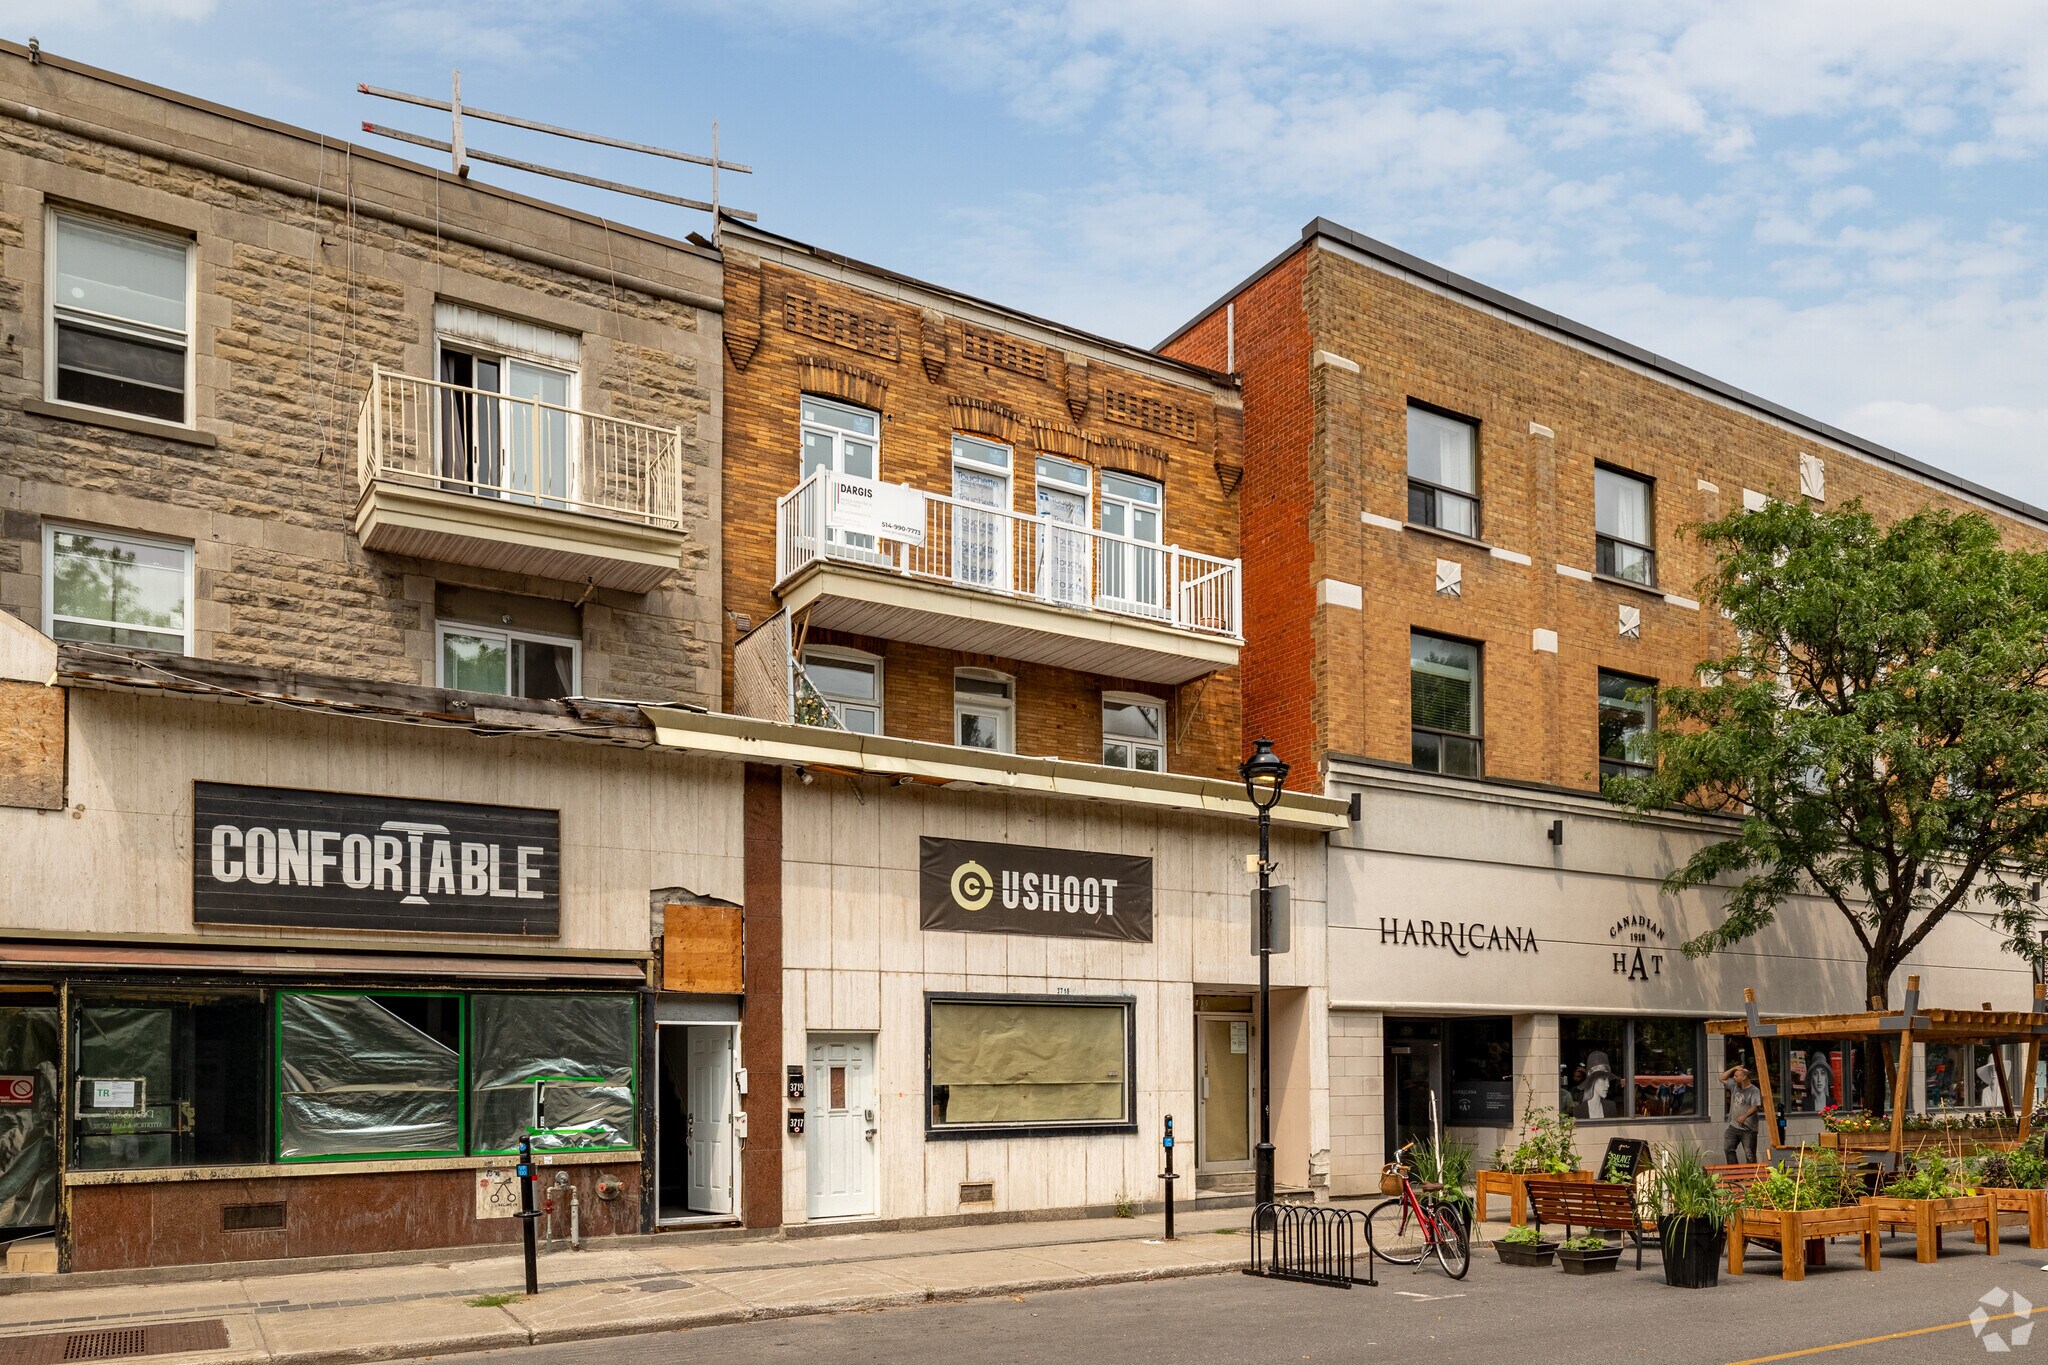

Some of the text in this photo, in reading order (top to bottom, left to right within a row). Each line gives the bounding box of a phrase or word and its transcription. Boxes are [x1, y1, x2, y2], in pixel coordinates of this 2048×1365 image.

[840, 483, 873, 498] DARGIS
[881, 521, 922, 536] 514-990-7773
[211, 820, 544, 905] CONFORTABLE
[1002, 870, 1118, 916] USHOOT
[1609, 914, 1665, 942] CANADIAN
[1379, 917, 1539, 956] HARRICANA
[1629, 932, 1646, 942] 1918
[1612, 947, 1663, 981] HAT
[97, 1088, 110, 1097] TR
[789, 1082, 804, 1091] 3719
[789, 1118, 804, 1127] 3717
